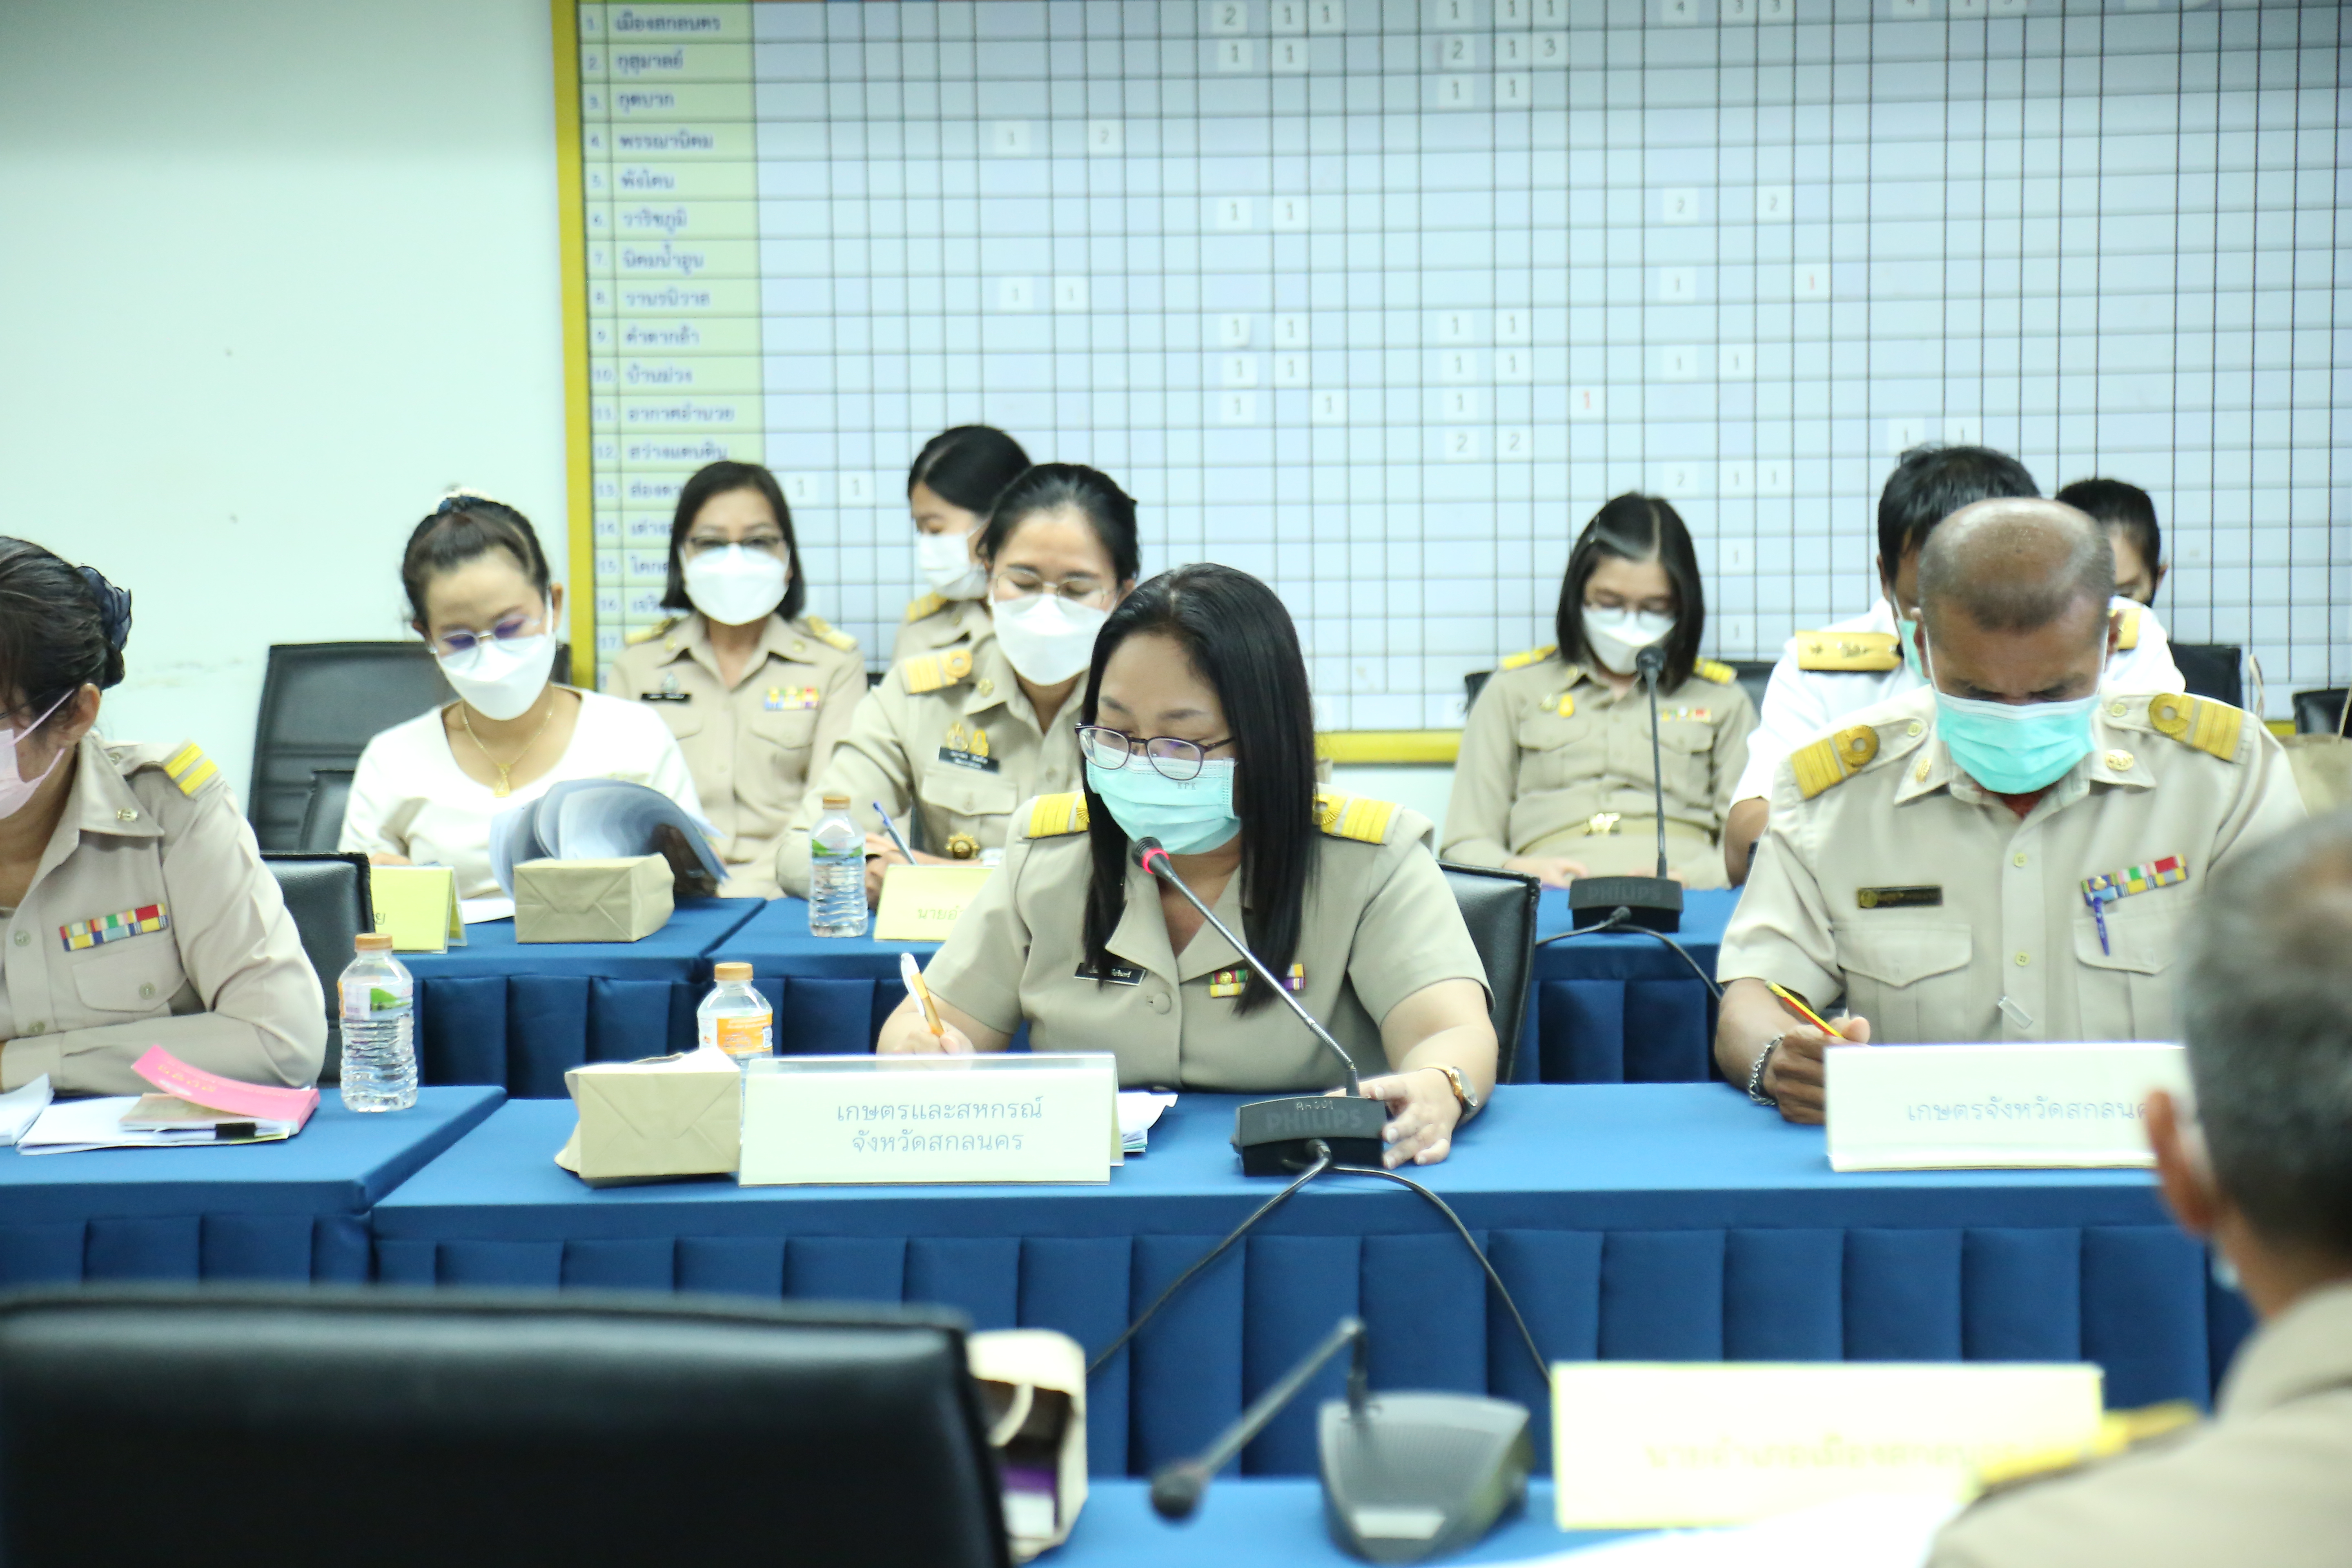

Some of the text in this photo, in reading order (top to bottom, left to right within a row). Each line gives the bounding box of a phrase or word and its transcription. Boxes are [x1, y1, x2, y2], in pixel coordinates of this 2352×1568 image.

[837, 1096, 1044, 1121] เกษตรและสหกรณ์
[1266, 1108, 1364, 1133] PHILIPS
[1908, 1095, 2147, 1121] เกษตรจังหวัดสกลนค
[852, 1129, 1024, 1153] จังหวัดสกลนคร
